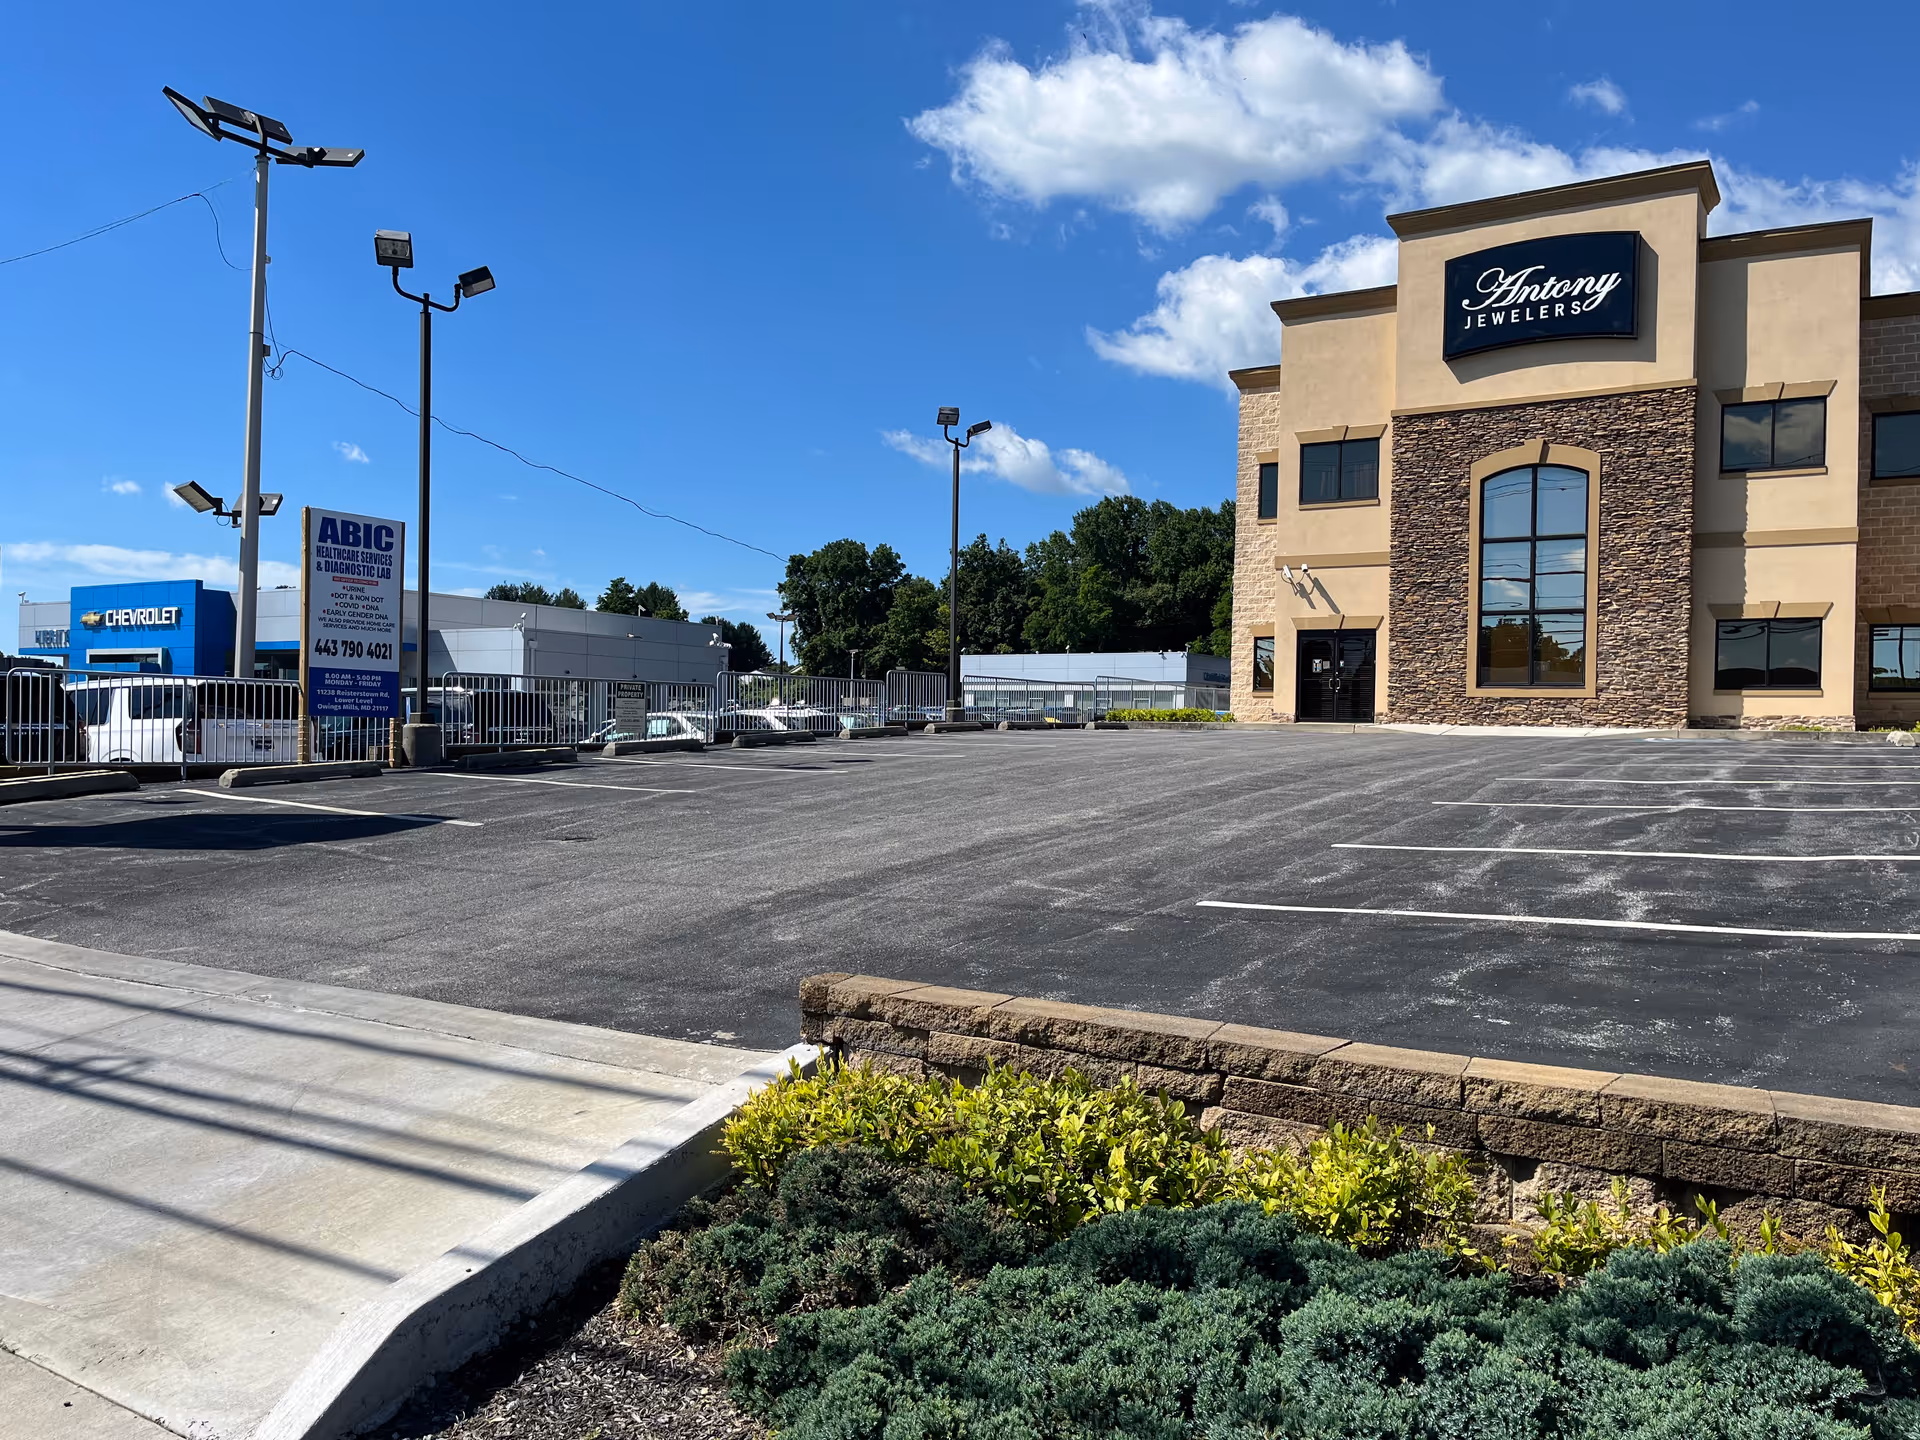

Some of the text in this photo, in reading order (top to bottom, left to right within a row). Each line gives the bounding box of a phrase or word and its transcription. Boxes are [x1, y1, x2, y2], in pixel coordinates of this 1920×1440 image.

[1461, 265, 1622, 312] Antony
[1464, 301, 1581, 330] JEWELERS
[318, 516, 394, 552] ABIC
[316, 545, 392, 567] HEALTHCARE SERVICES
[316, 560, 391, 579] & DIAGNOSTIC LAB
[334, 592, 348, 600] DOT
[346, 585, 365, 593] URINE
[105, 607, 178, 626] CHEVROLET
[348, 611, 373, 619] GENDER
[323, 622, 347, 630] SERVICES
[315, 638, 392, 660] 443 790 4021
[336, 689, 378, 697] Reisterstown
[317, 703, 341, 711] Owings
